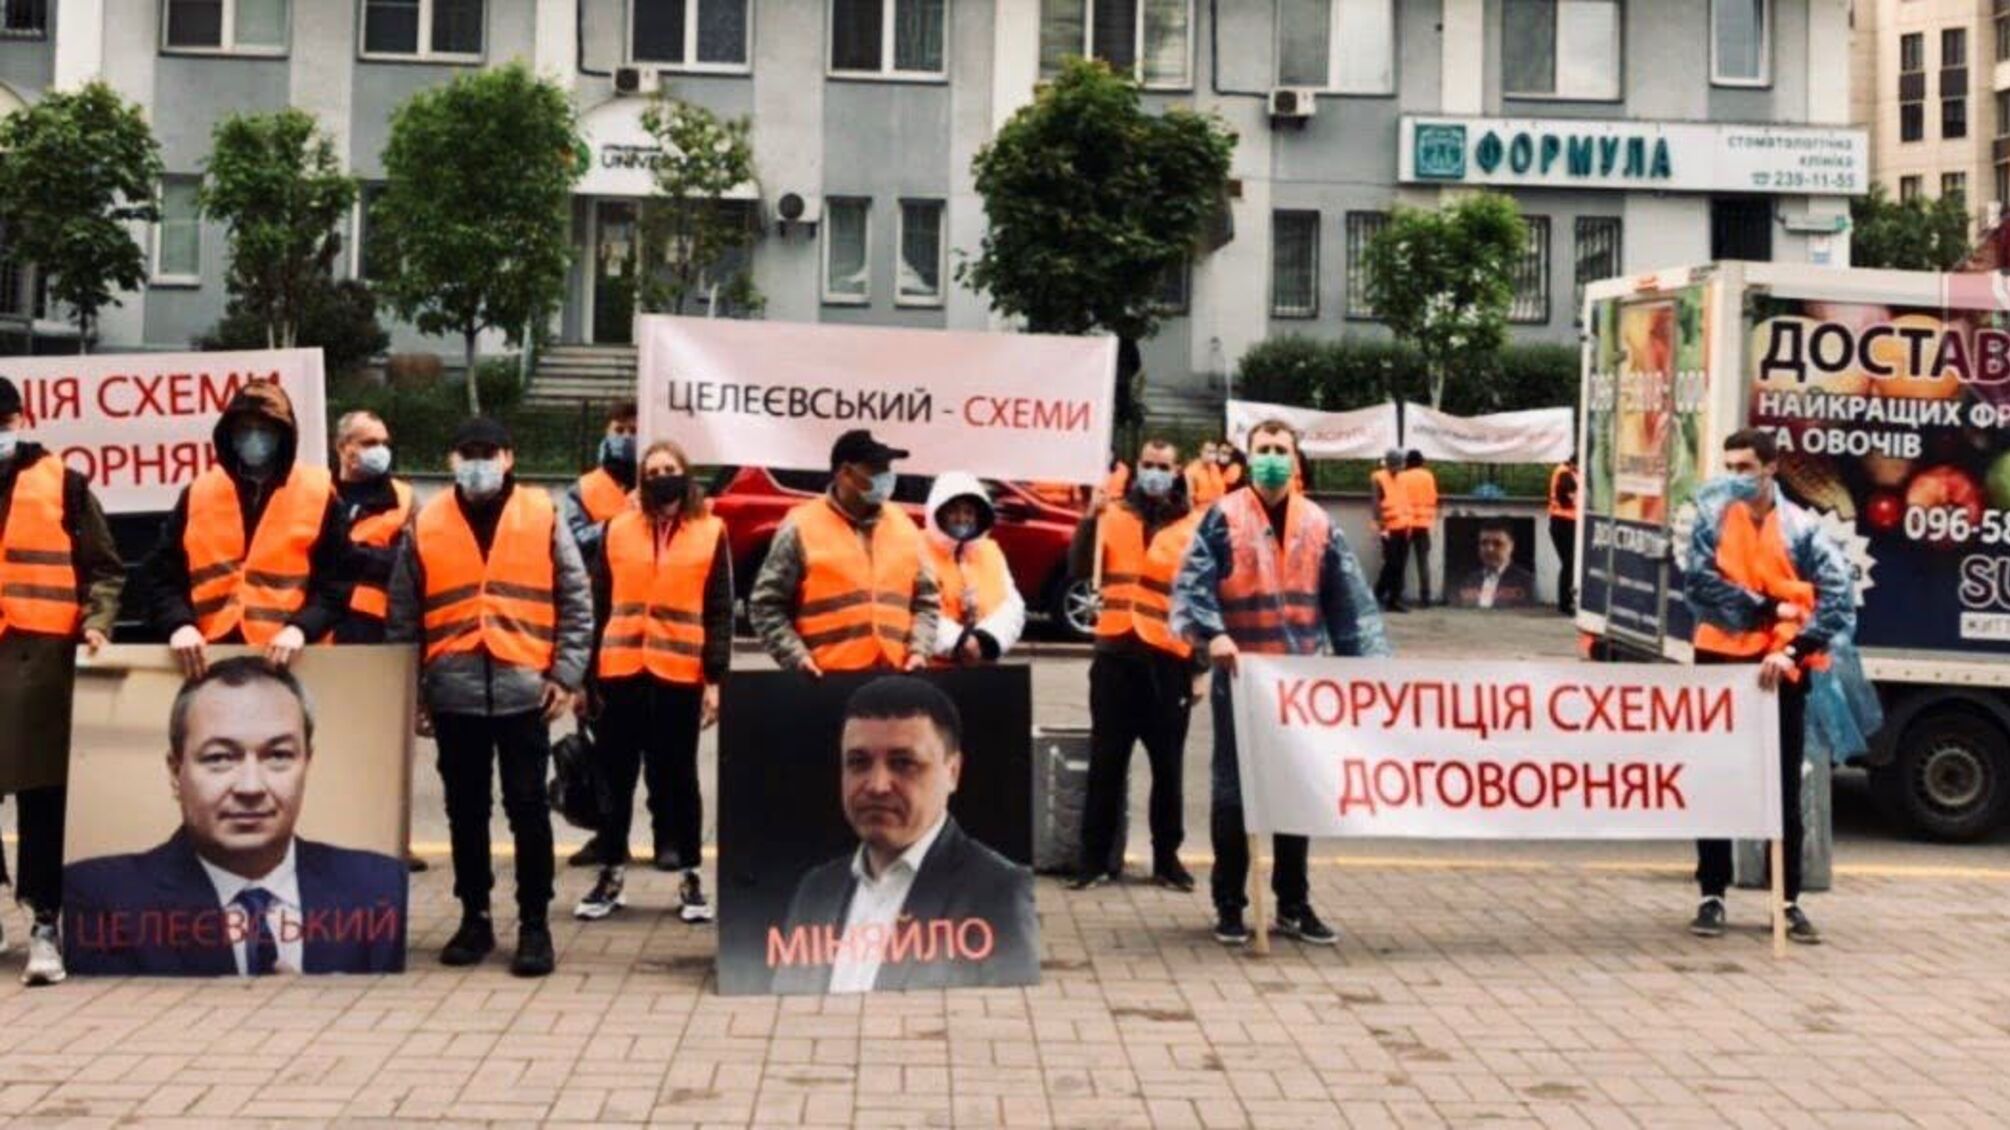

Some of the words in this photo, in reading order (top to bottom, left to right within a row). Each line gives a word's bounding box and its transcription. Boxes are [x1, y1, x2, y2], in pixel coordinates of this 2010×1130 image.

[1475, 130, 1673, 178] ФОРМУЛА
[97, 371, 280, 418] СХЕМ
[668, 380, 932, 424] ЦЕЛЕЄВСЬКИЙ
[963, 396, 1091, 430] СХЕМИ
[1759, 387, 1962, 429] НАЙКРАЩИХ
[1803, 429, 1922, 458] ОВОЧІВ
[1277, 679, 1531, 738] КОРУПЦІЯ
[1548, 685, 1734, 733] СХЕМИ
[1339, 758, 1686, 815] ДОГОВОРНЯК
[76, 899, 400, 950] ЦЕЛЕЄВСЬКИЙ
[766, 915, 994, 967] МІНЯЙЛО
